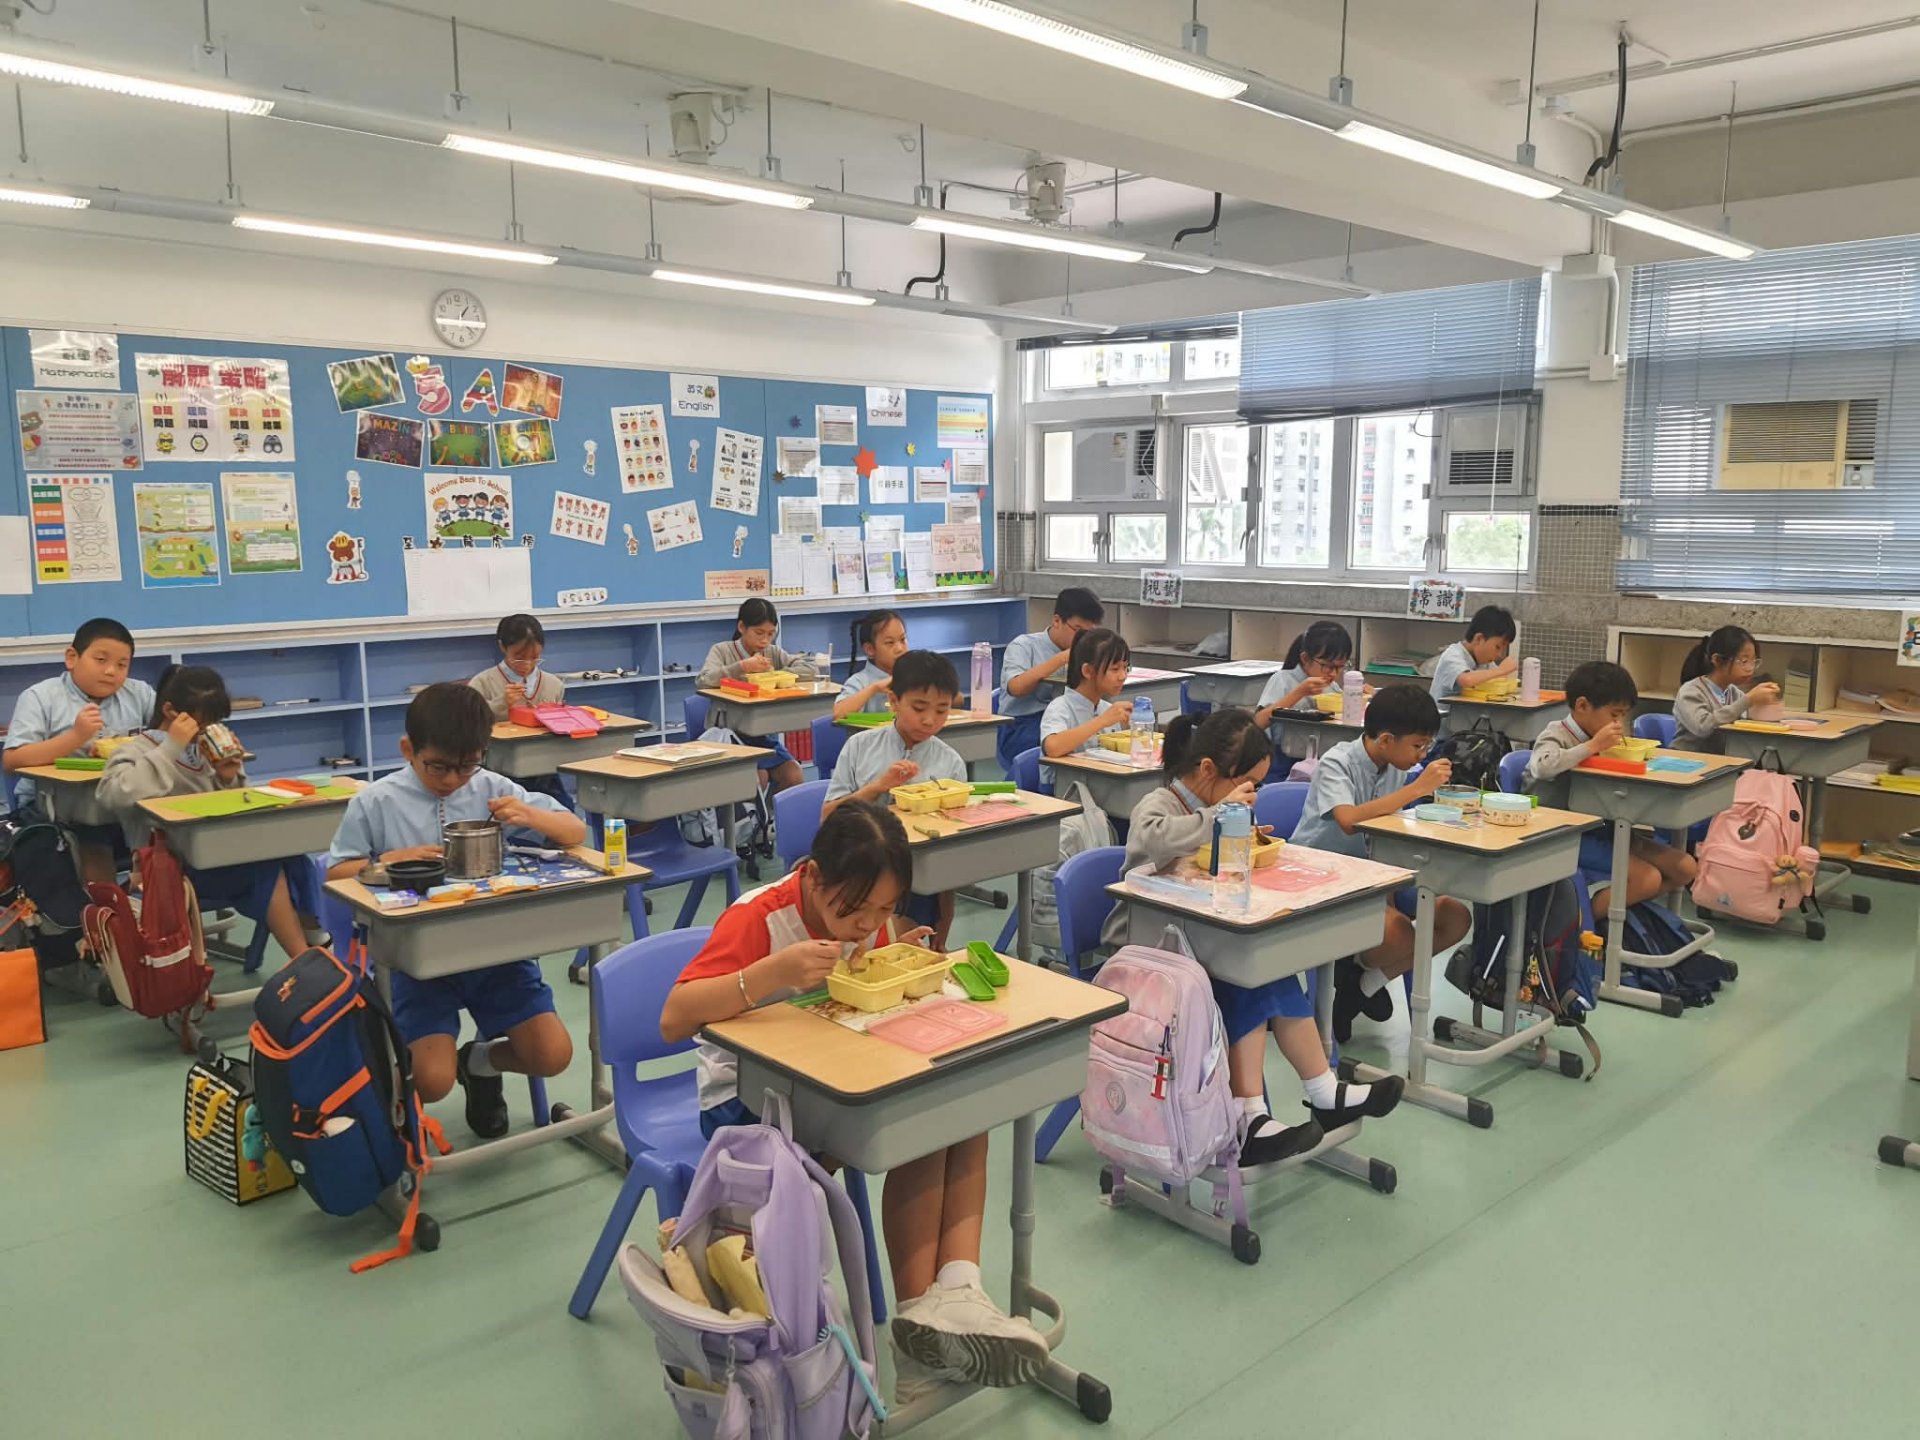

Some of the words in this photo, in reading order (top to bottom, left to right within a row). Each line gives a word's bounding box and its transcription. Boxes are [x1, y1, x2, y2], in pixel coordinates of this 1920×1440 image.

[39, 367, 116, 379] Mathematics
[687, 384, 703, 395] 英文
[678, 400, 714, 411] English
[871, 409, 903, 418] Chinese
[428, 479, 458, 496] Welcome
[459, 476, 476, 484] Back
[478, 476, 486, 485] To
[487, 479, 509, 496] School
[1148, 579, 1175, 598] 視藝
[1419, 587, 1455, 610] 常識
